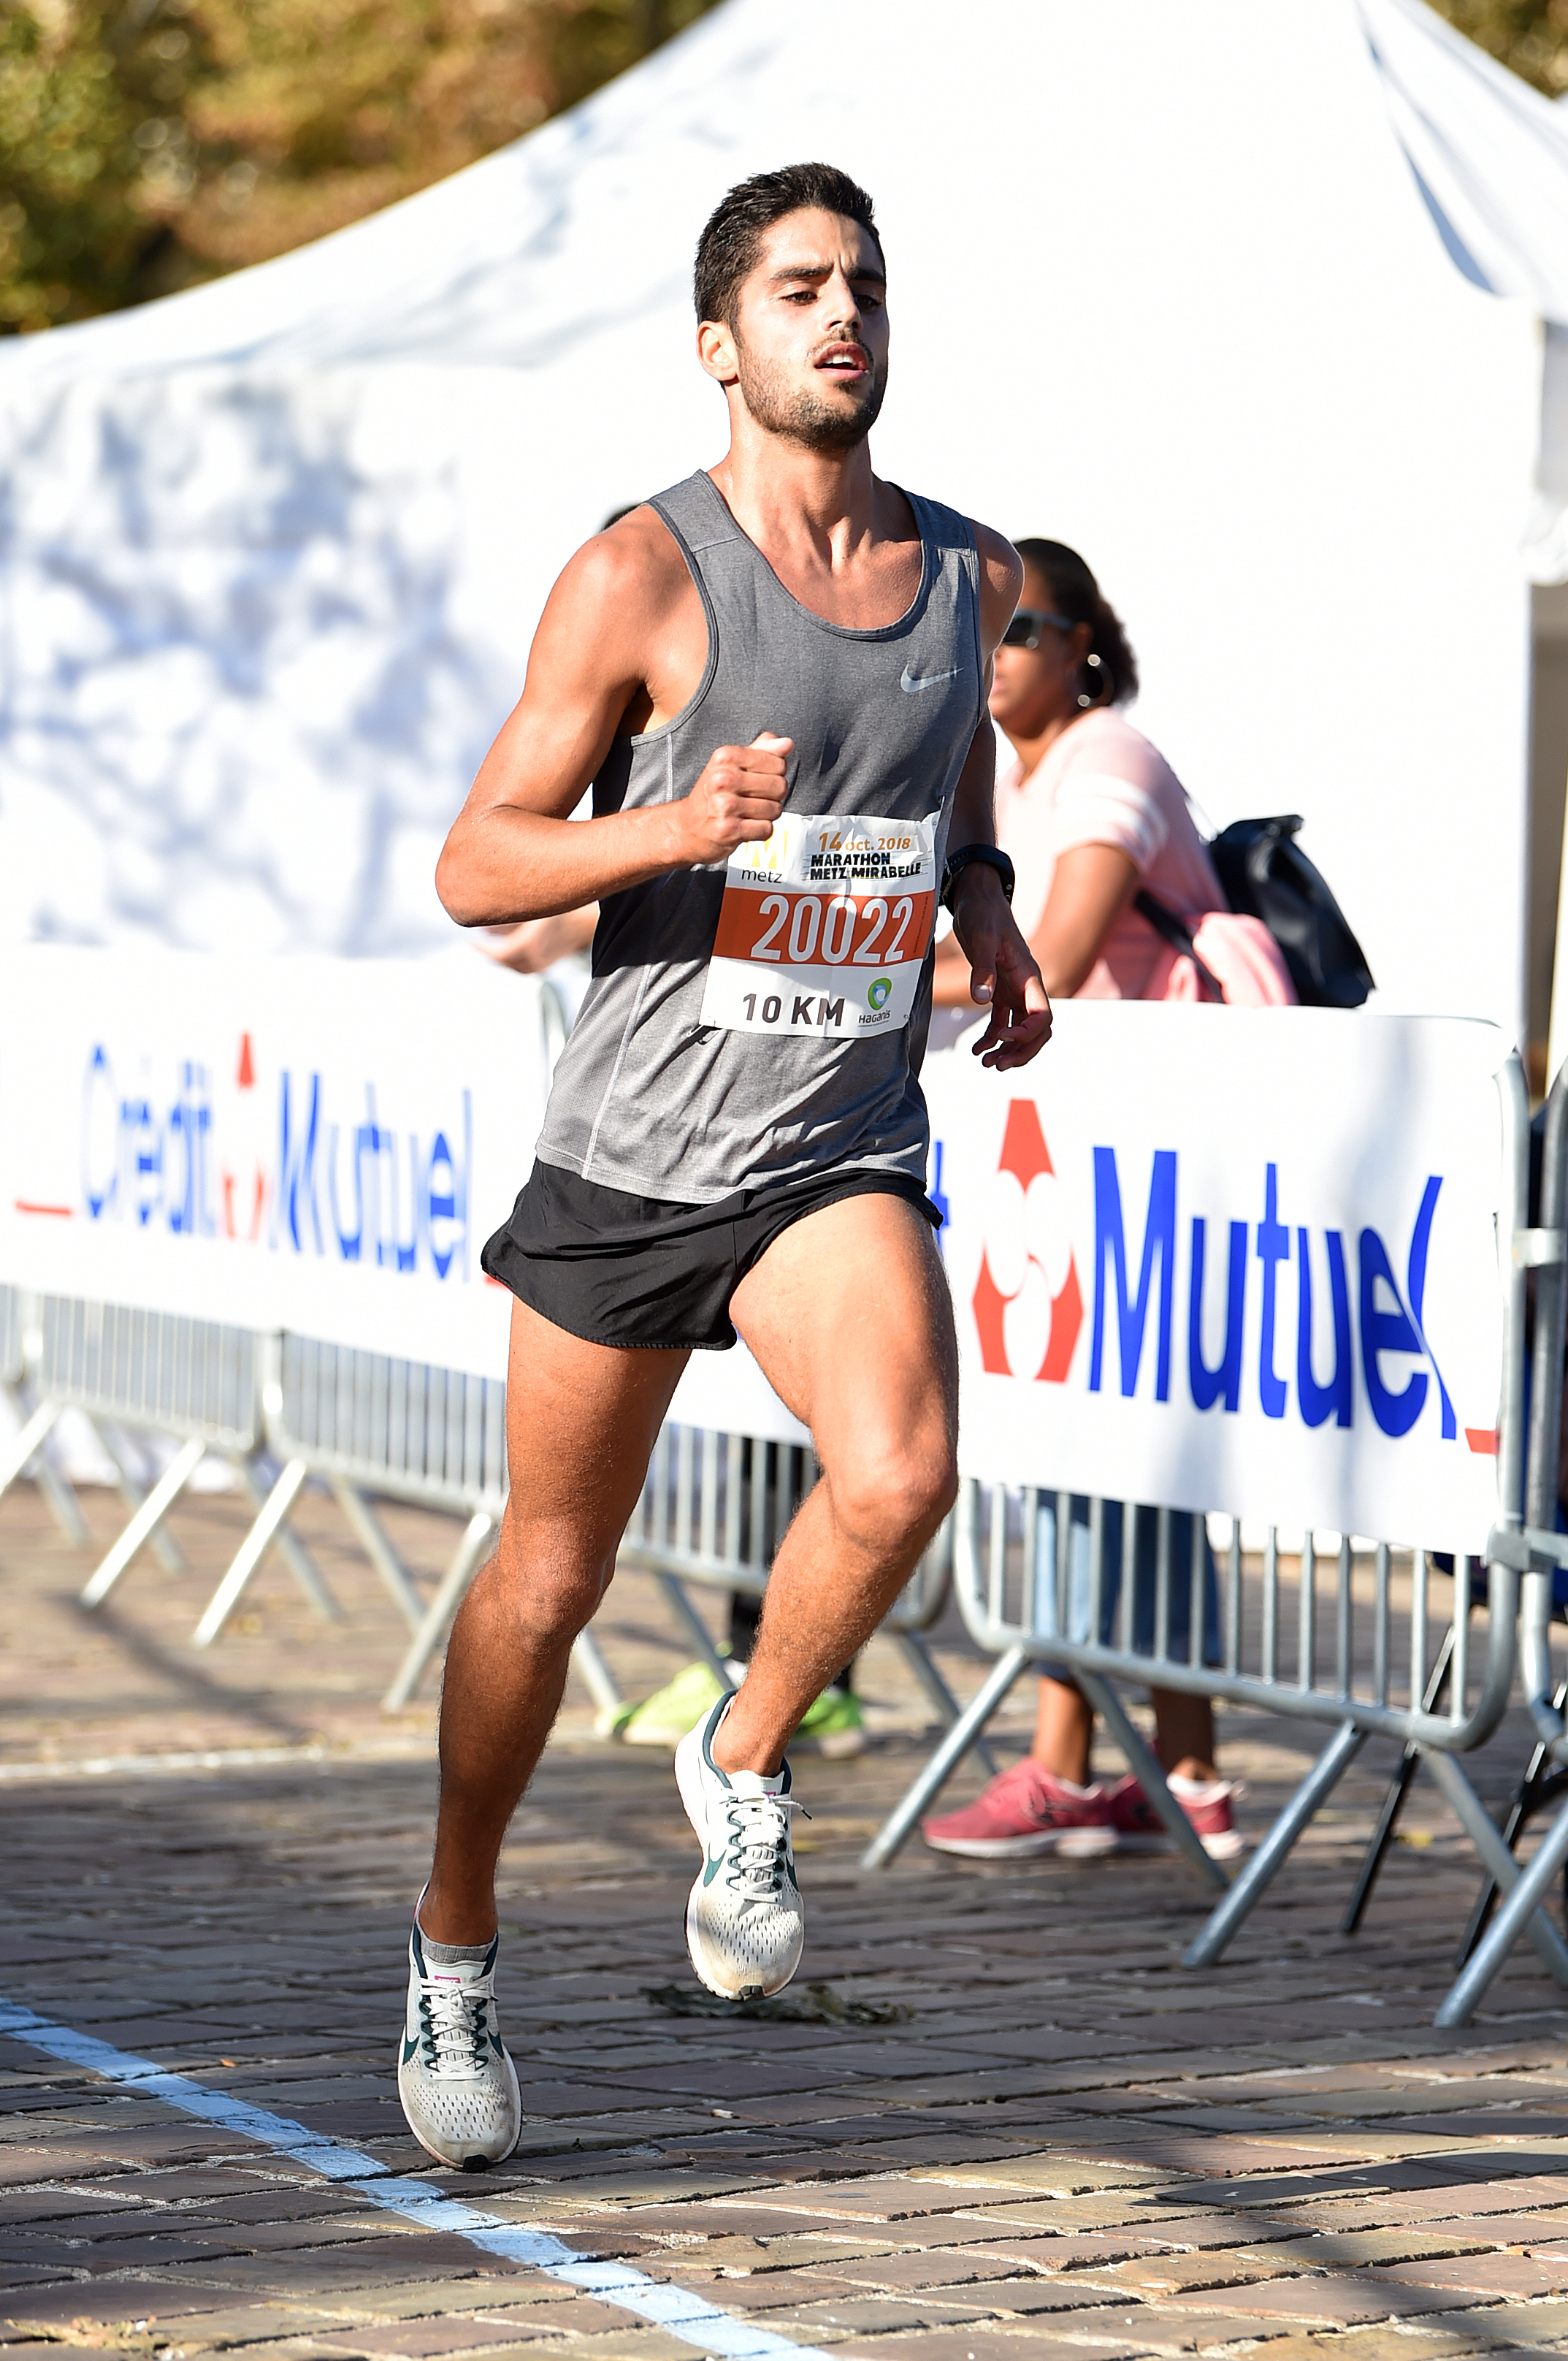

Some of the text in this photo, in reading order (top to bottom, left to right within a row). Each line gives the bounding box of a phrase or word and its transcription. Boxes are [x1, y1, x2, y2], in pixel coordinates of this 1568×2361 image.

[819, 832, 911, 852] 14 oct. 2018
[811, 852, 891, 867] MARATHON
[741, 869, 783, 884] metz
[809, 862, 922, 880] METZ MIRABELLE
[749, 894, 914, 964] 20022
[742, 993, 846, 1027] 10 KM
[1088, 1145, 1456, 1441] Mutuel
